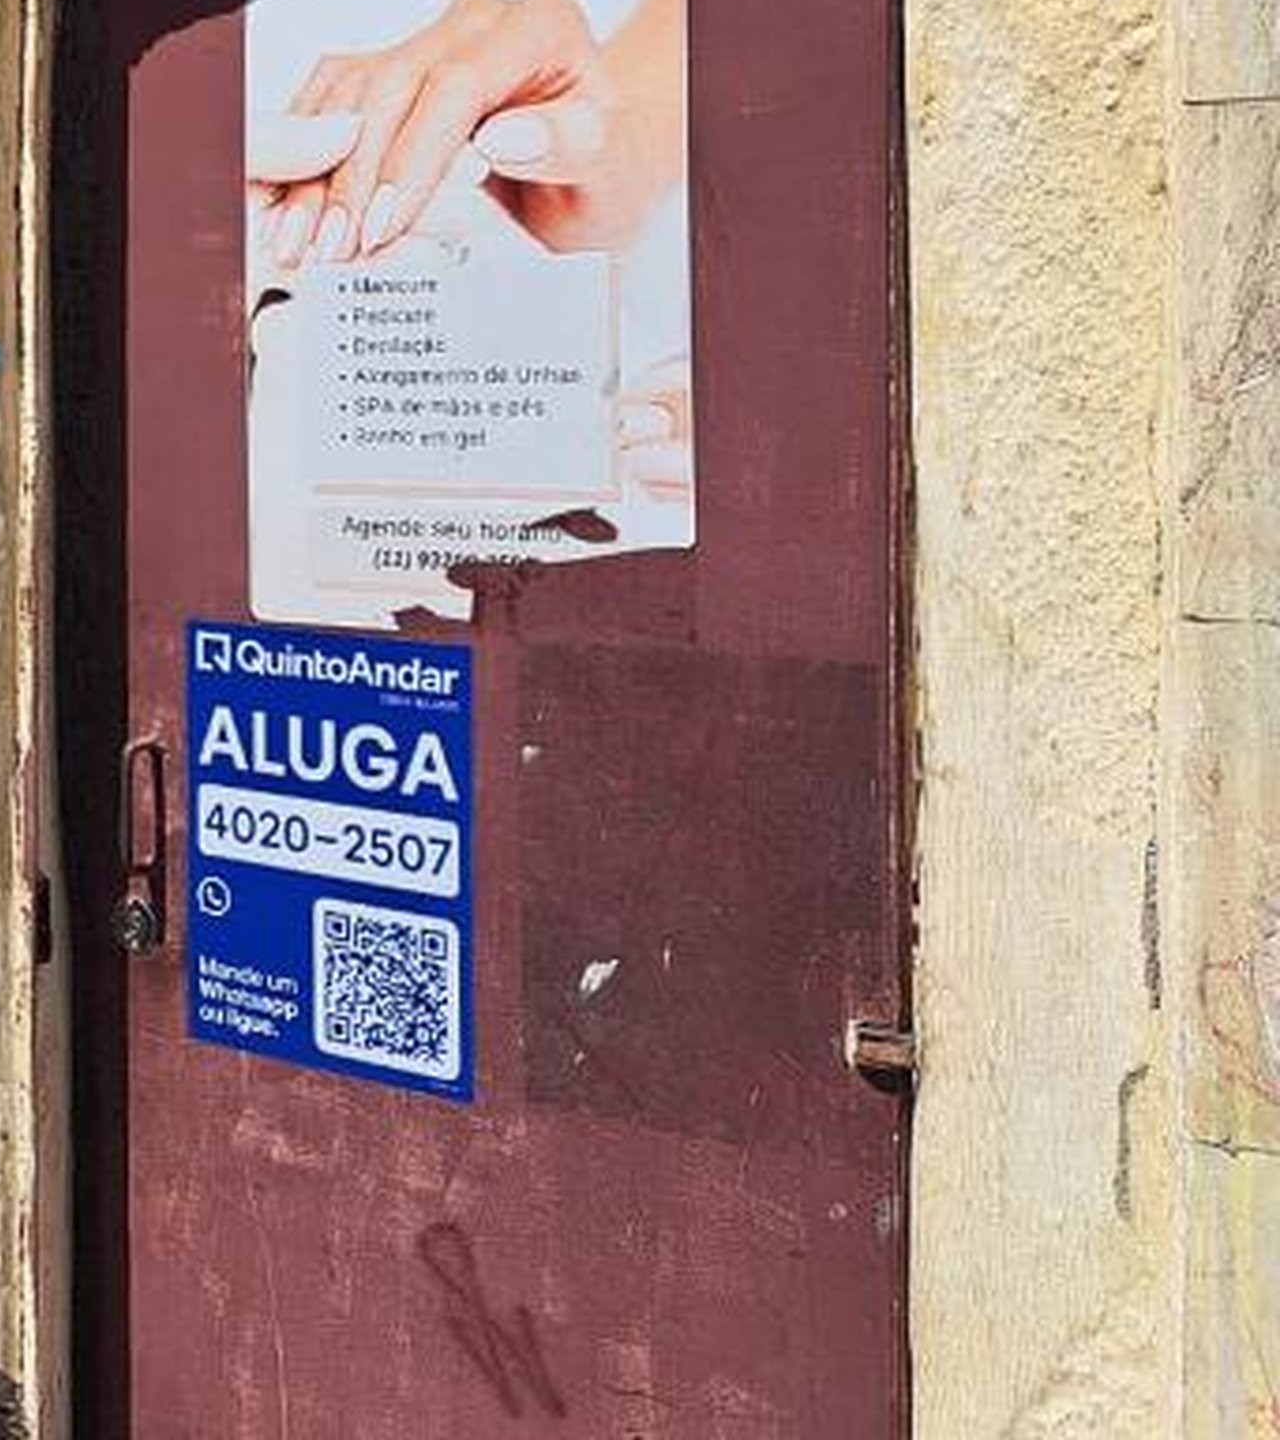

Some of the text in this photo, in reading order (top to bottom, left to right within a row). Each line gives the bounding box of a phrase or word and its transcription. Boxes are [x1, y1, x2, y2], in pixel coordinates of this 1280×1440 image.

[341, 516, 426, 540] Agende
[430, 522, 473, 541] seu
[236, 639, 460, 695] QuintoAndar
[199, 704, 460, 803] ALUGA
[204, 803, 453, 876] 4020-2507
[199, 954, 298, 996] Mande um
